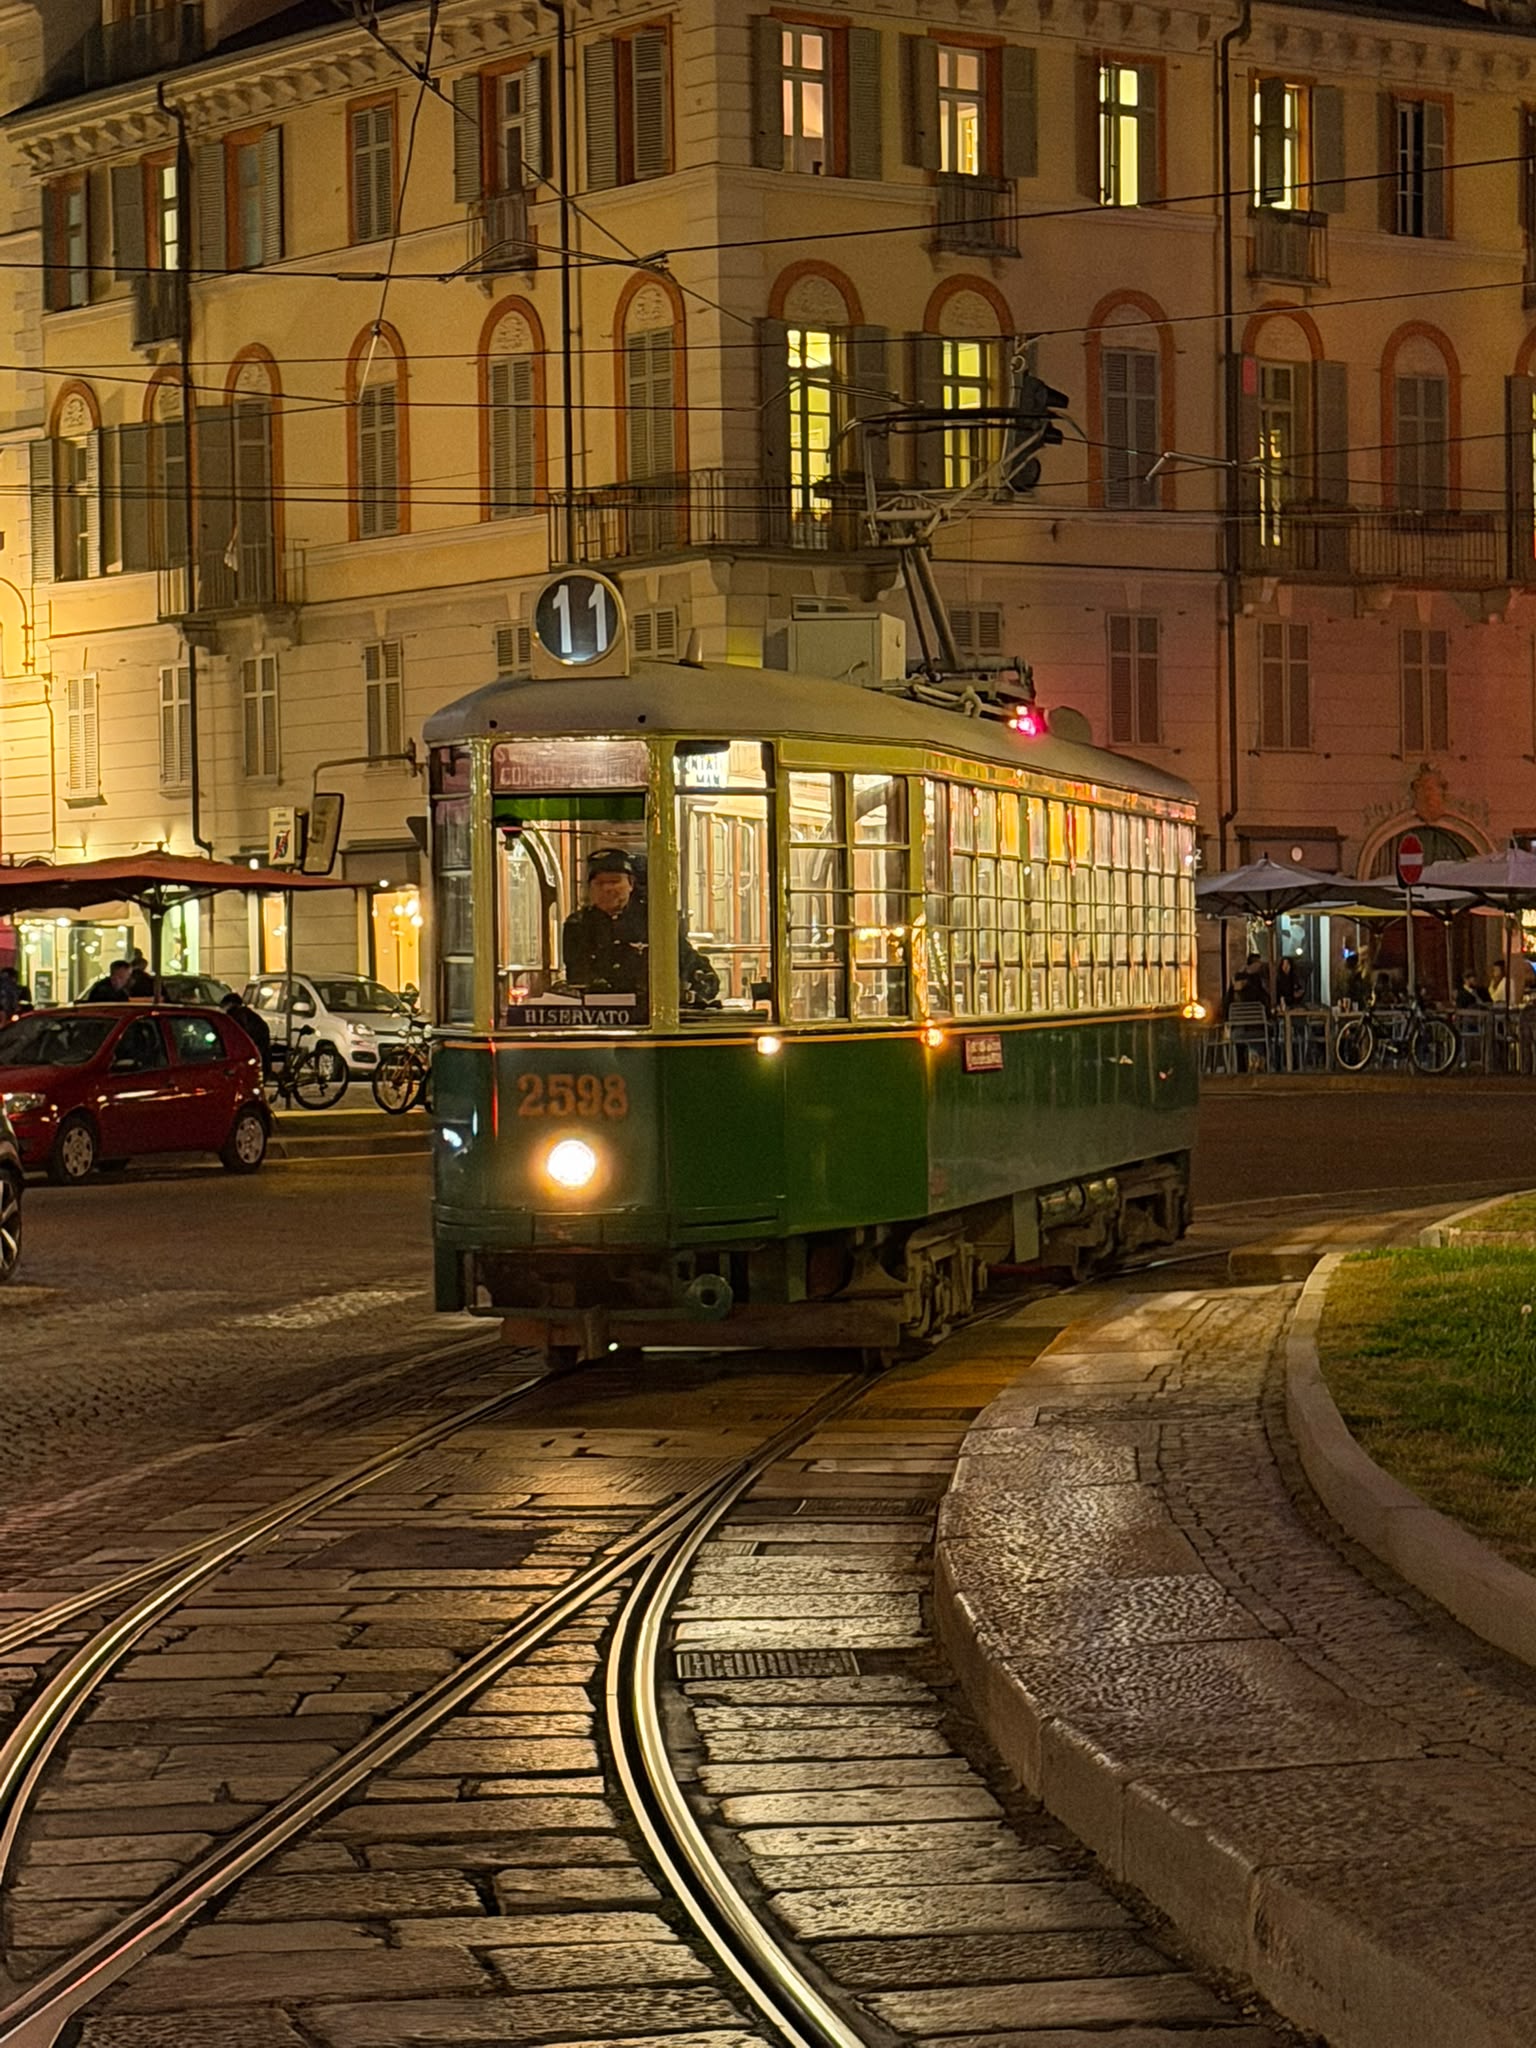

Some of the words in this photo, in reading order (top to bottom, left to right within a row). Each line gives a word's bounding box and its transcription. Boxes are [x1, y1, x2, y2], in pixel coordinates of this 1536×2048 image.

[552, 583, 607, 653] 11
[525, 1009, 630, 1025] RISERVATO
[518, 1073, 629, 1117] 2598
